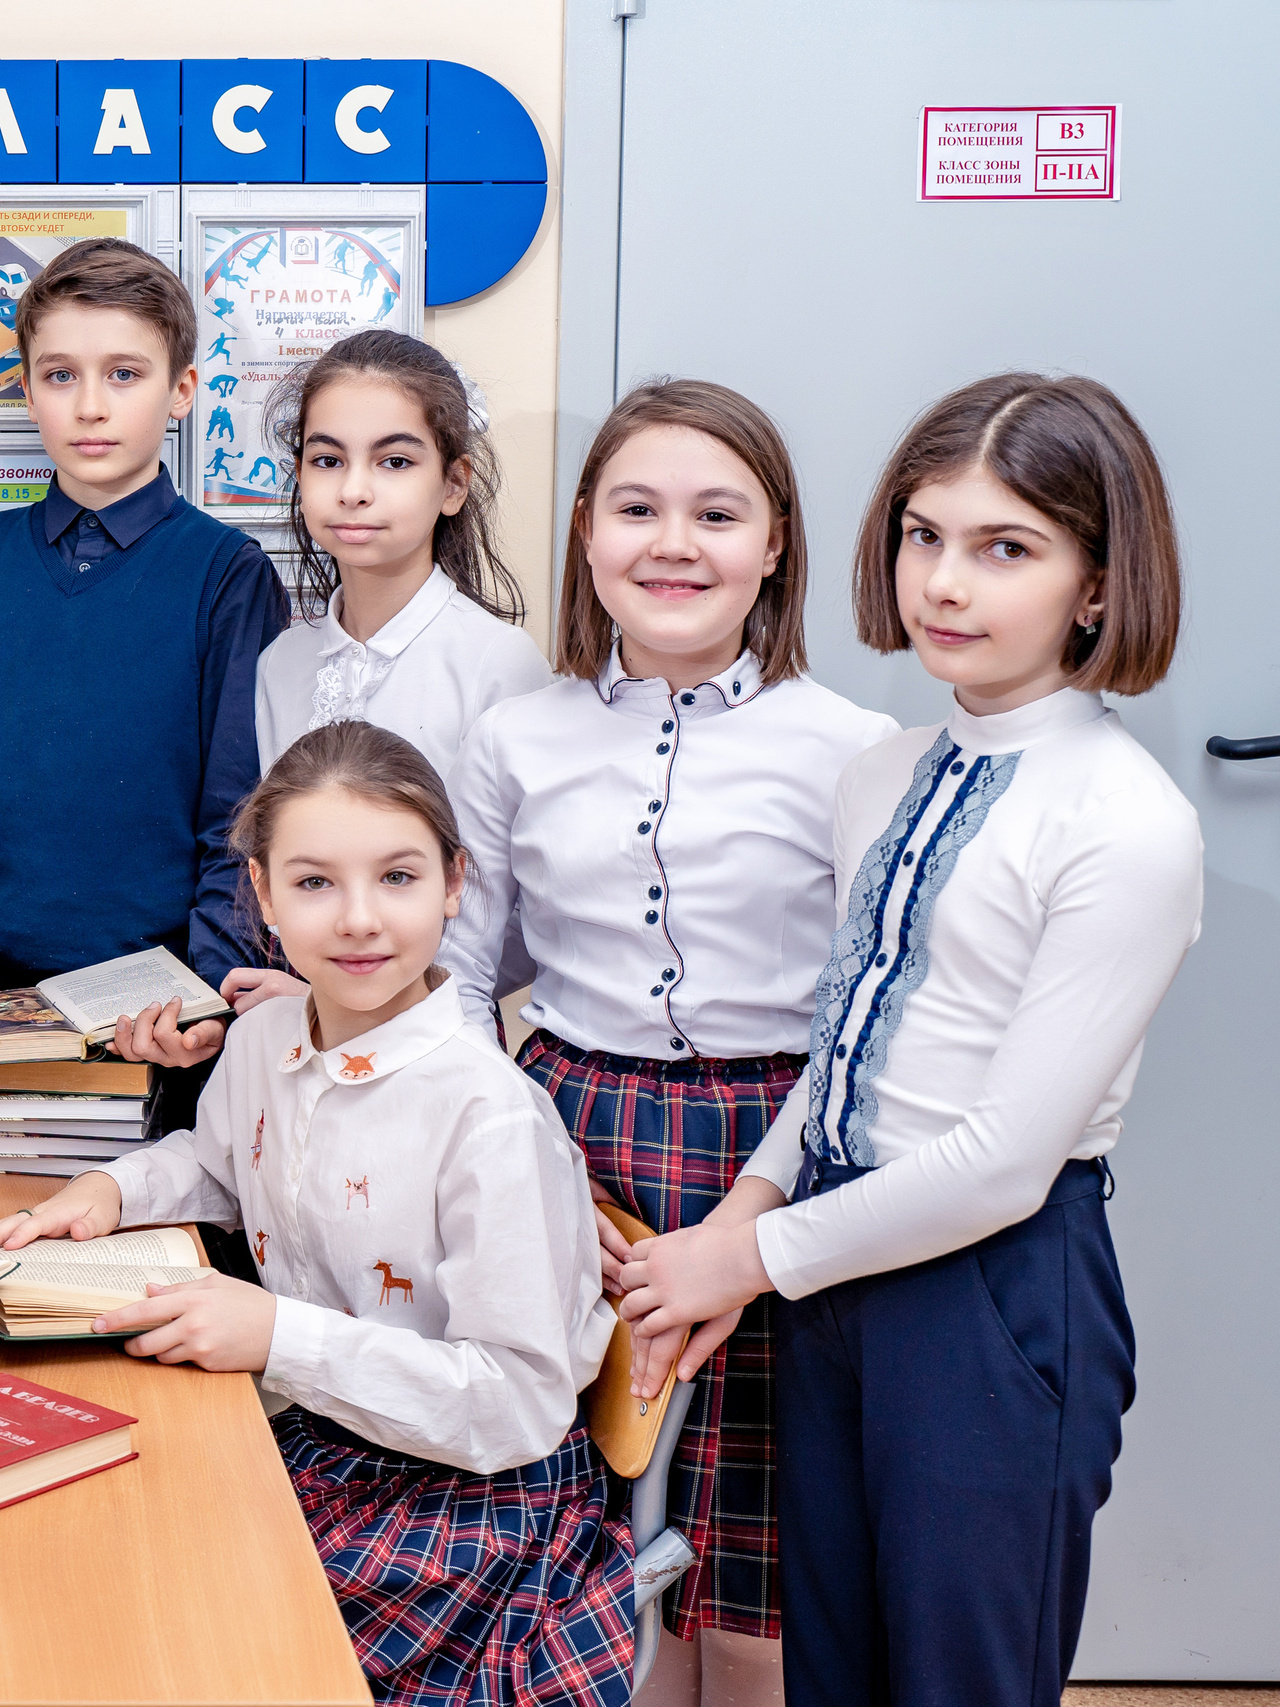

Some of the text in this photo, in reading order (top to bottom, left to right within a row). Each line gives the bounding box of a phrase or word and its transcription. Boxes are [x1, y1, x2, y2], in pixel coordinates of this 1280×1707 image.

[944, 122, 1018, 133] КАТЕГОРИЯ
[1059, 122, 1085, 140] В3
[938, 136, 1023, 147] ПОМЕЩЕНИЯ
[938, 160, 1020, 171] КЛАСС ЗОНЫ
[936, 174, 1022, 185] ПОМЕЩЕНИЯ
[11, 212, 41, 221] СЗАДИ
[43, 212, 50, 220] И
[52, 212, 95, 221] СПЕРЕДИ,
[36, 224, 65, 234] УЕДЕТ
[250, 289, 352, 304] ГРАМОТА
[255, 309, 348, 321] Награждается
[295, 328, 340, 339] класс
[286, 347, 324, 356] место
[241, 371, 281, 382] «Удаль
[1, 488, 30, 499] 8.15
